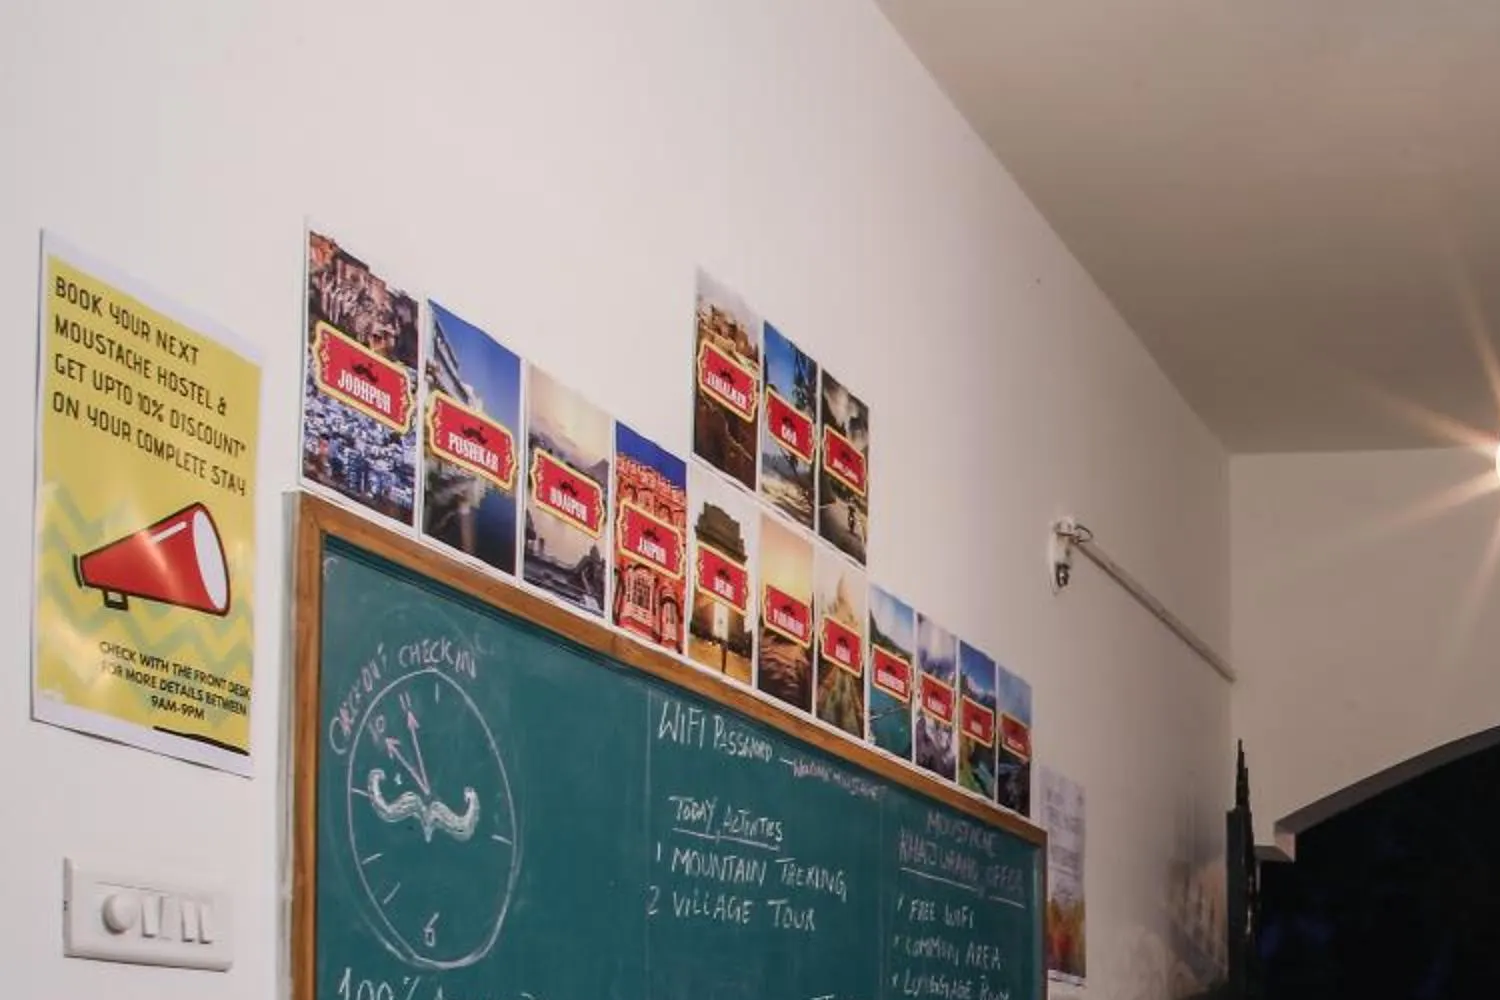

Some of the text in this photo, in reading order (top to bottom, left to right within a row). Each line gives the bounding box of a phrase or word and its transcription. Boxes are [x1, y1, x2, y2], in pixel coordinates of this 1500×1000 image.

[56, 276, 199, 365] BOOK YOUR NEXT
[55, 314, 227, 416] MOUSTACHE HOSTEL &
[55, 353, 87, 383] GET
[93, 369, 132, 406] UPTO
[137, 392, 164, 422] 10%
[53, 391, 246, 496] ON YOUR COMPLETE STAY
[100, 641, 137, 663] CHECK
[139, 652, 169, 674] WITH
[172, 663, 192, 679] THE
[193, 670, 227, 691] FRONT
[126, 667, 159, 689] MORE
[160, 678, 203, 702] DETAILS
[206, 691, 247, 717] BETWEEN
[151, 695, 205, 721] 9AM-9PM
[658, 701, 706, 748] WIFI
[671, 847, 767, 887] MOUNTAIN
[423, 911, 440, 948] 6
[647, 885, 661, 915] 2
[767, 898, 817, 931] TOUR
